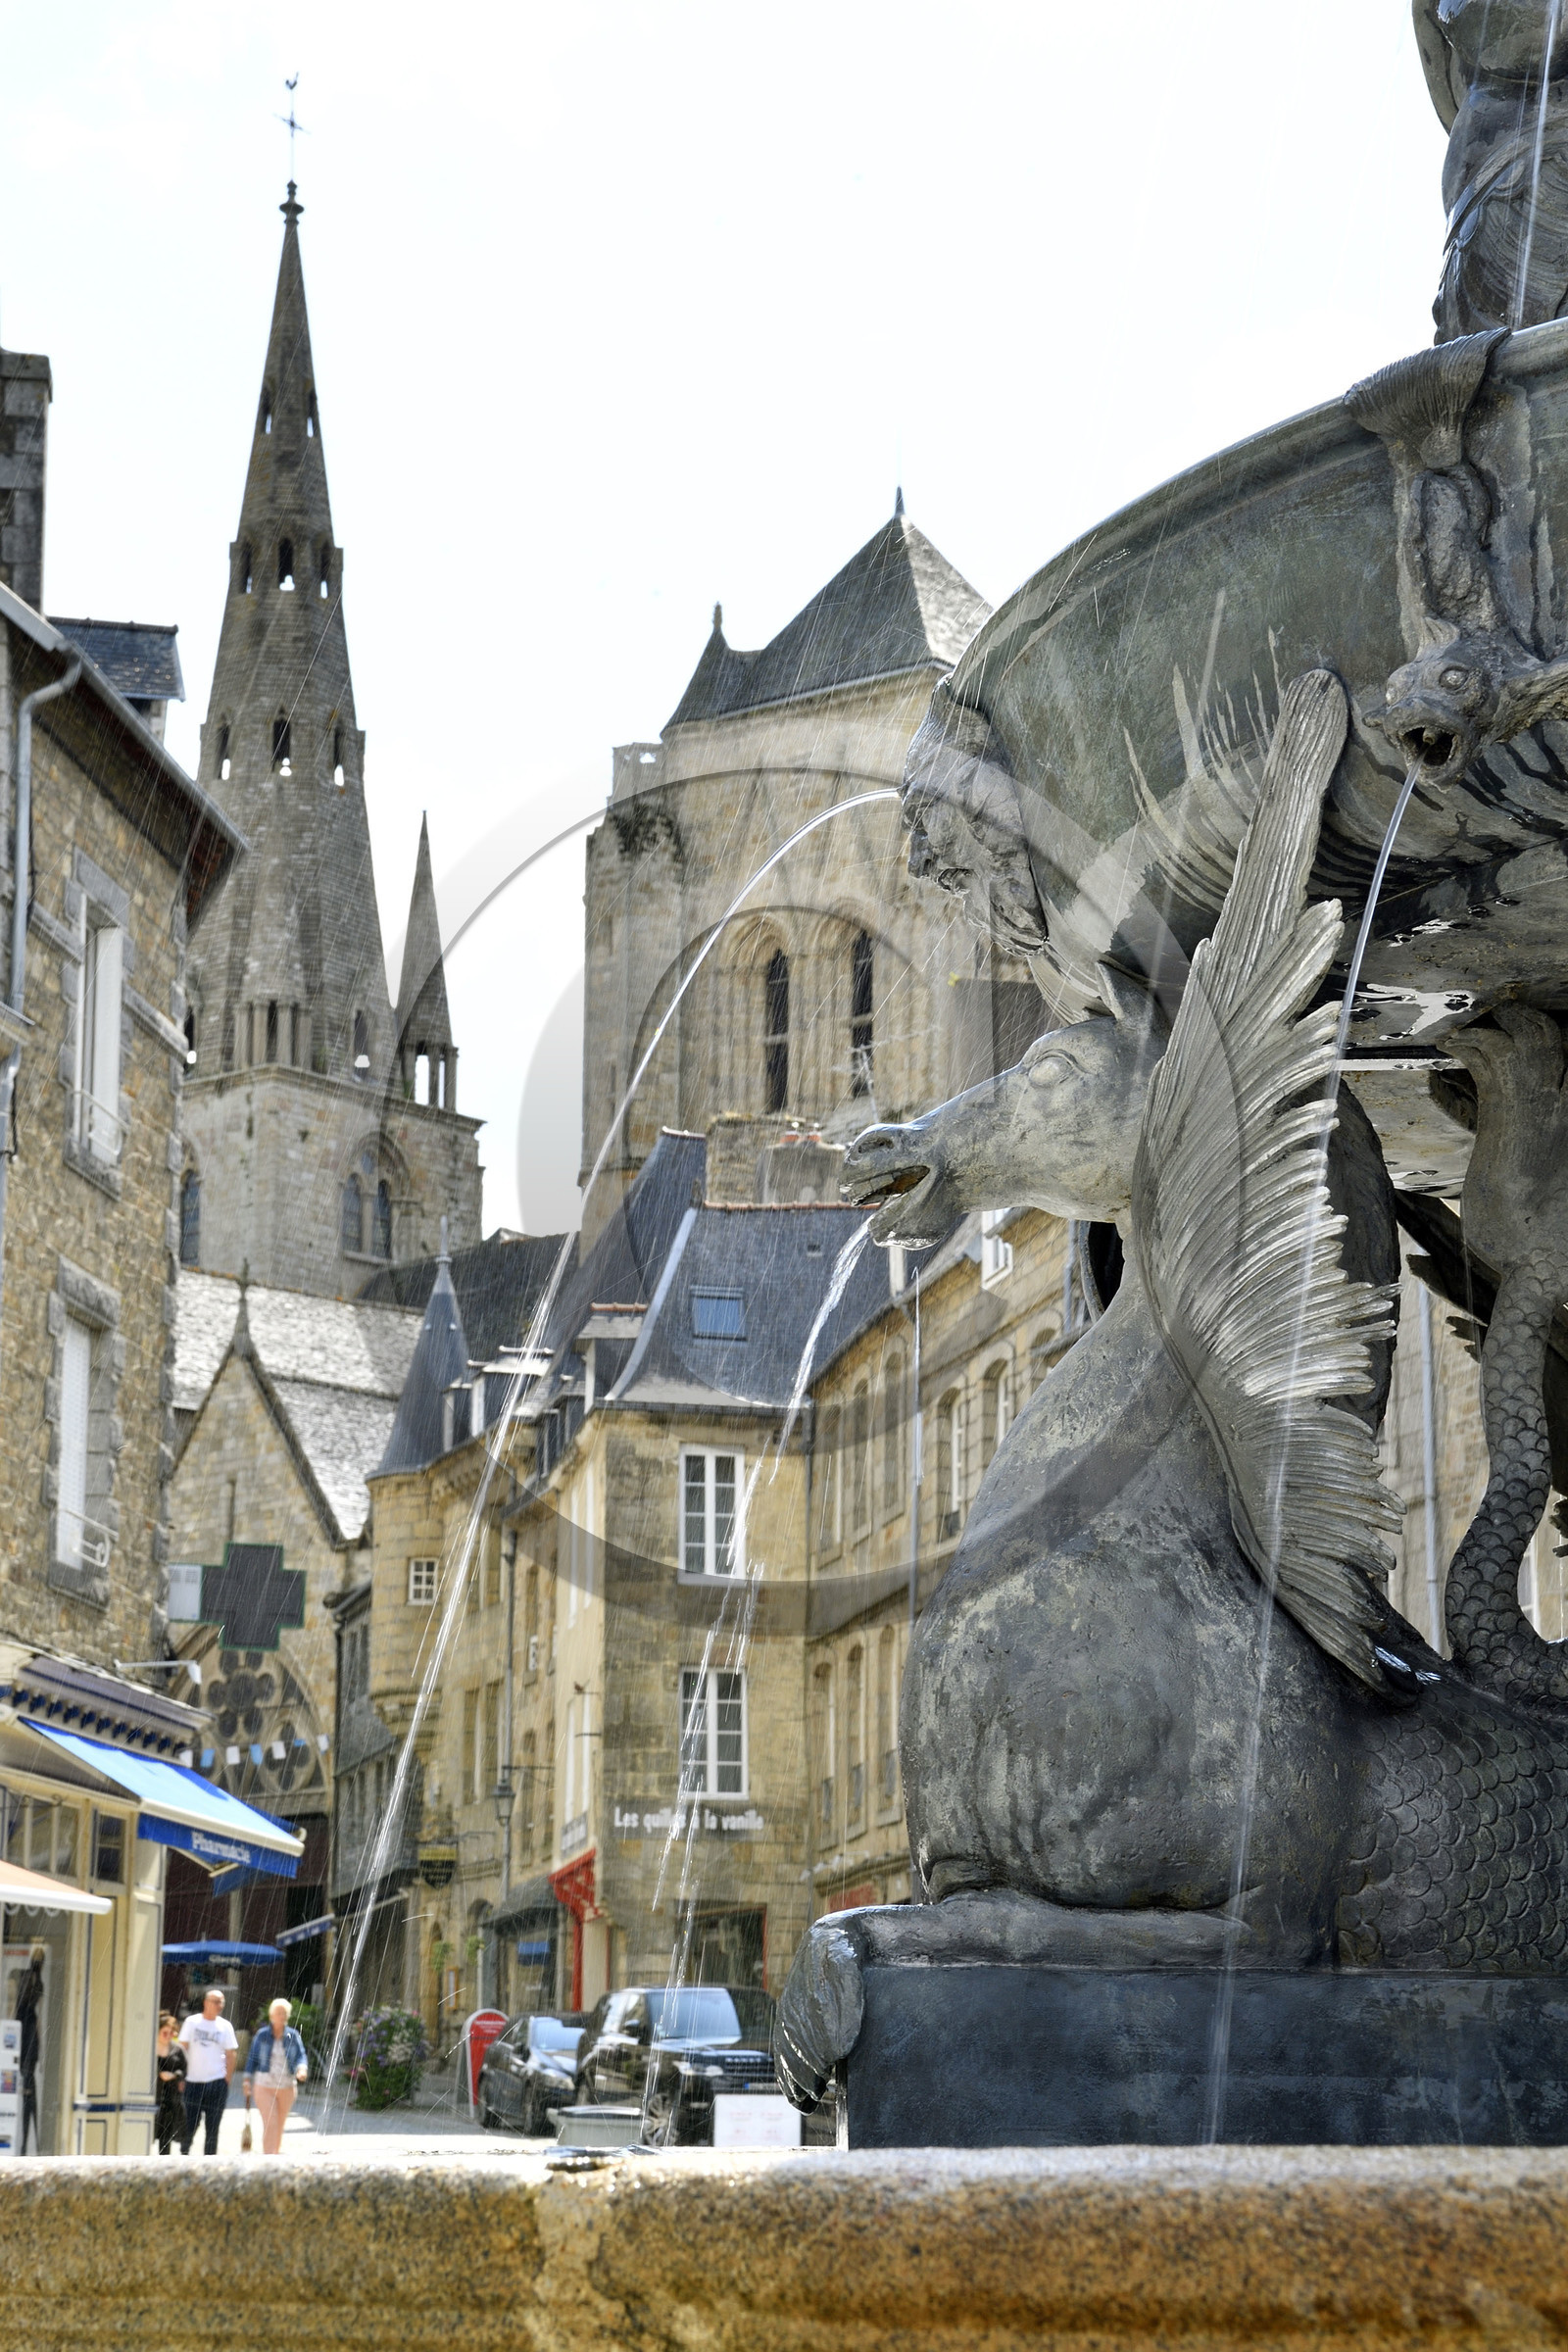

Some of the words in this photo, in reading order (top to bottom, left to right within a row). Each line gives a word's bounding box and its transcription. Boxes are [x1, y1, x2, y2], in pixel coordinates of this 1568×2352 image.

[614, 1806, 639, 1828] Les
[705, 1808, 717, 1830] la
[721, 1809, 763, 1831] vanille
[191, 1831, 251, 1864] Pharmacie
